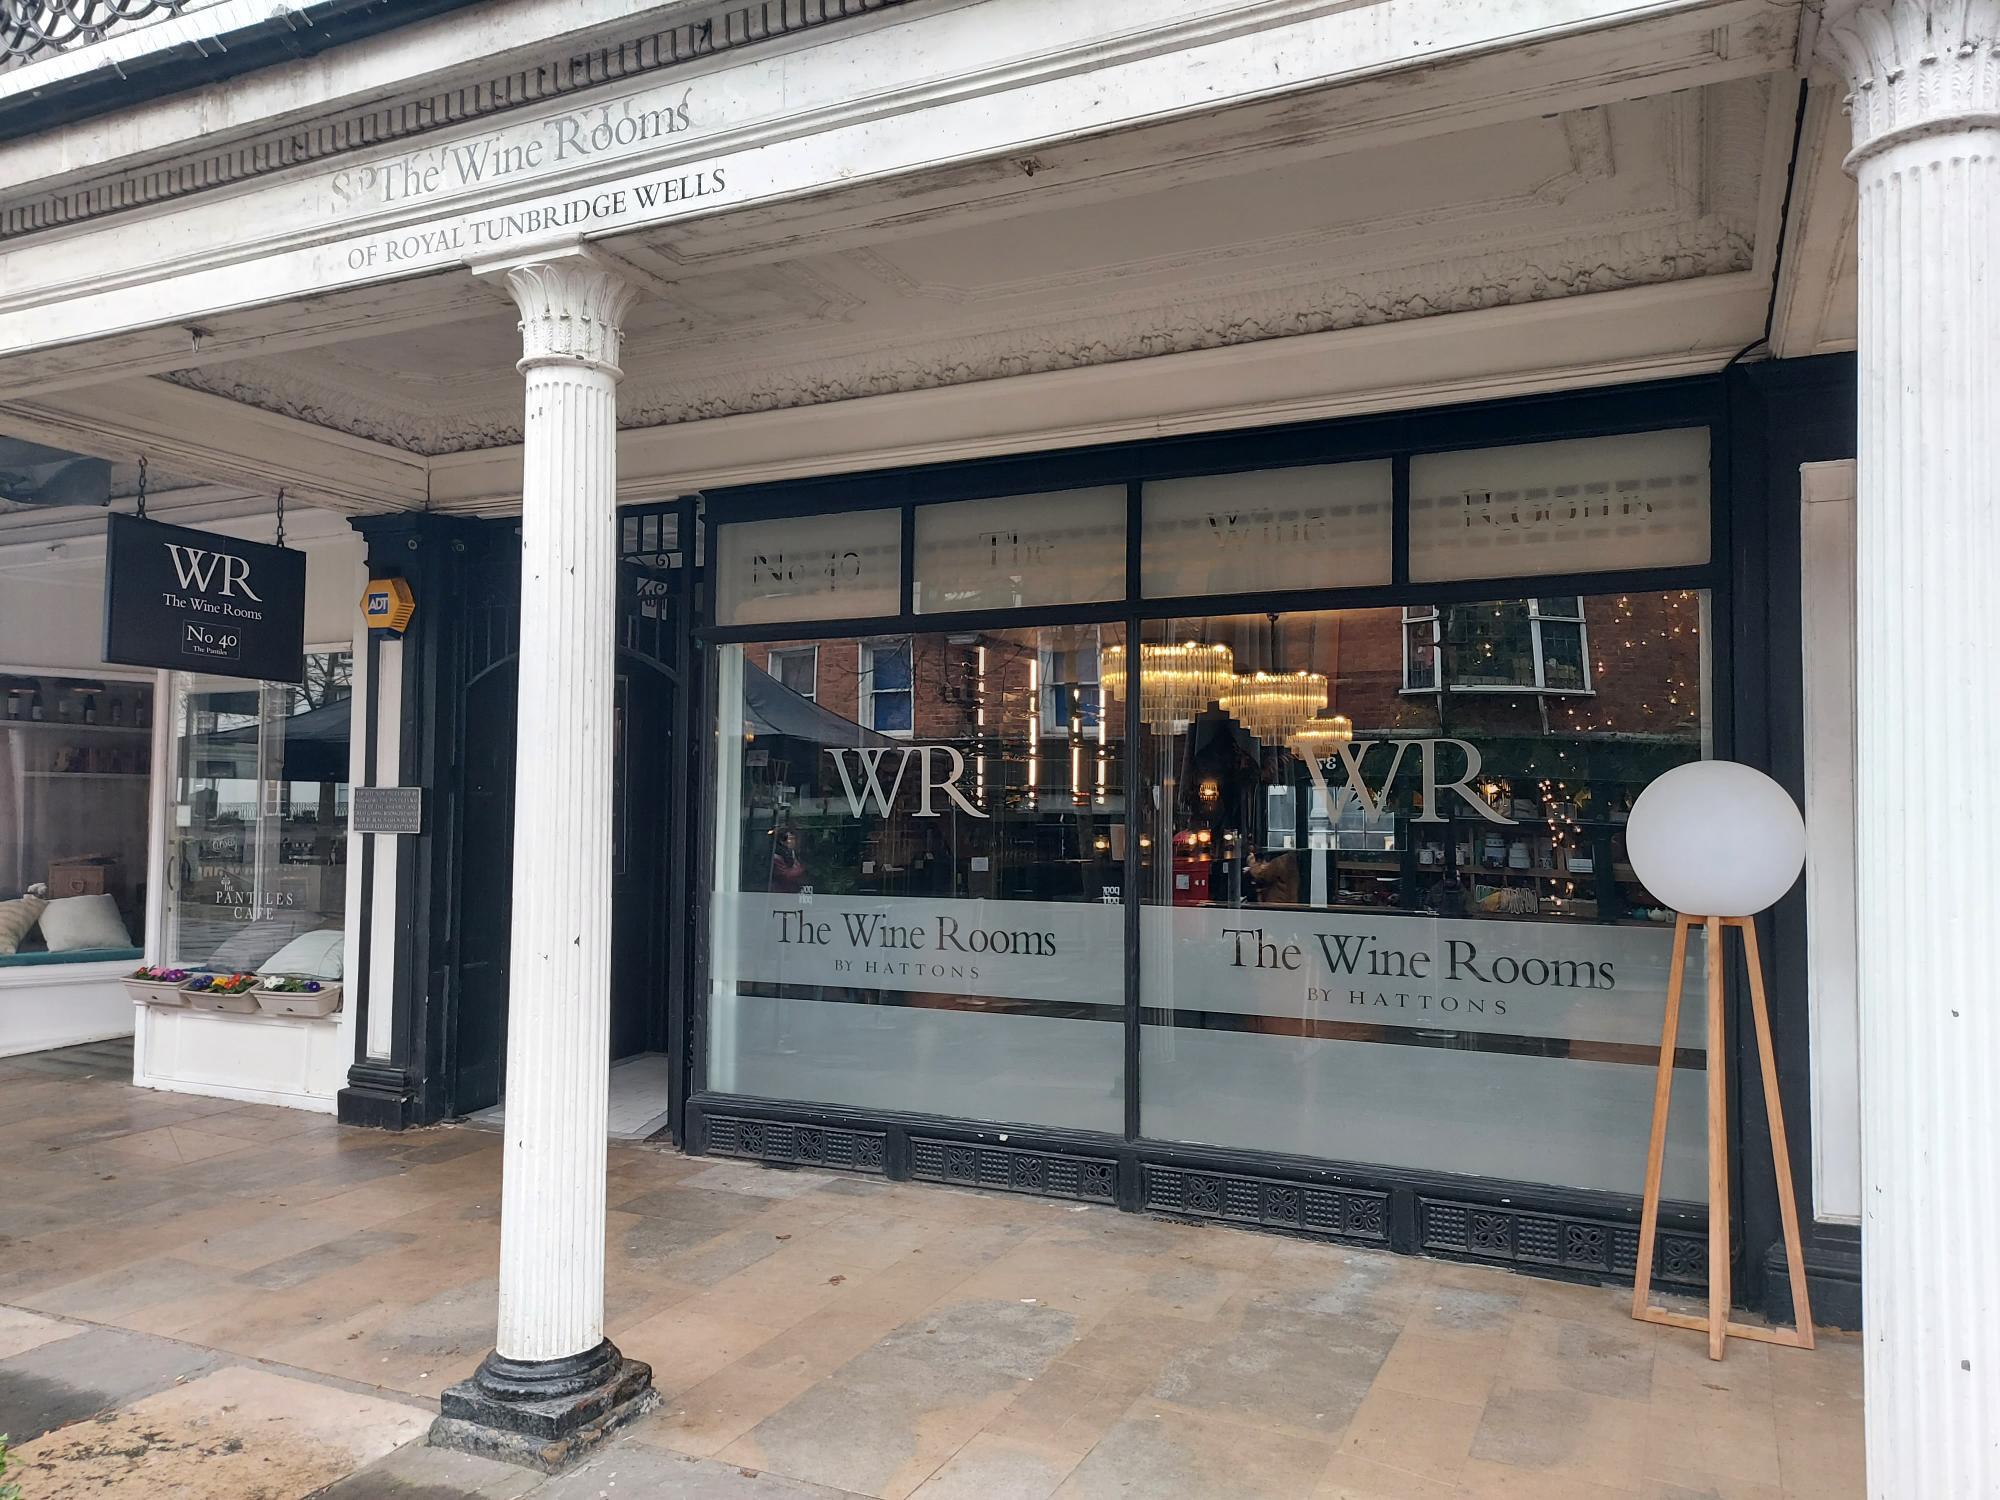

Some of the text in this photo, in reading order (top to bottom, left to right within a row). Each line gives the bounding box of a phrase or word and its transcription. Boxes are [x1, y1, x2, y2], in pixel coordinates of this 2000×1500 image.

[378, 101, 692, 202] The Wine Rooms
[348, 168, 726, 271] OF ROYAL TUNBRIDGE WELLS
[164, 543, 263, 602] WR
[163, 593, 263, 620] The Wine Rooms
[368, 597, 388, 613] ADT
[186, 625, 238, 649] No 40
[824, 745, 991, 820] WR
[1300, 738, 1520, 826] WR
[215, 891, 294, 906] PANTILES
[773, 910, 1057, 957] The Wine Rooms
[834, 960, 981, 980] BY HATTONS
[1222, 928, 1616, 991] The Wine Rooms
[1307, 987, 1508, 1016] BY HATTONS
